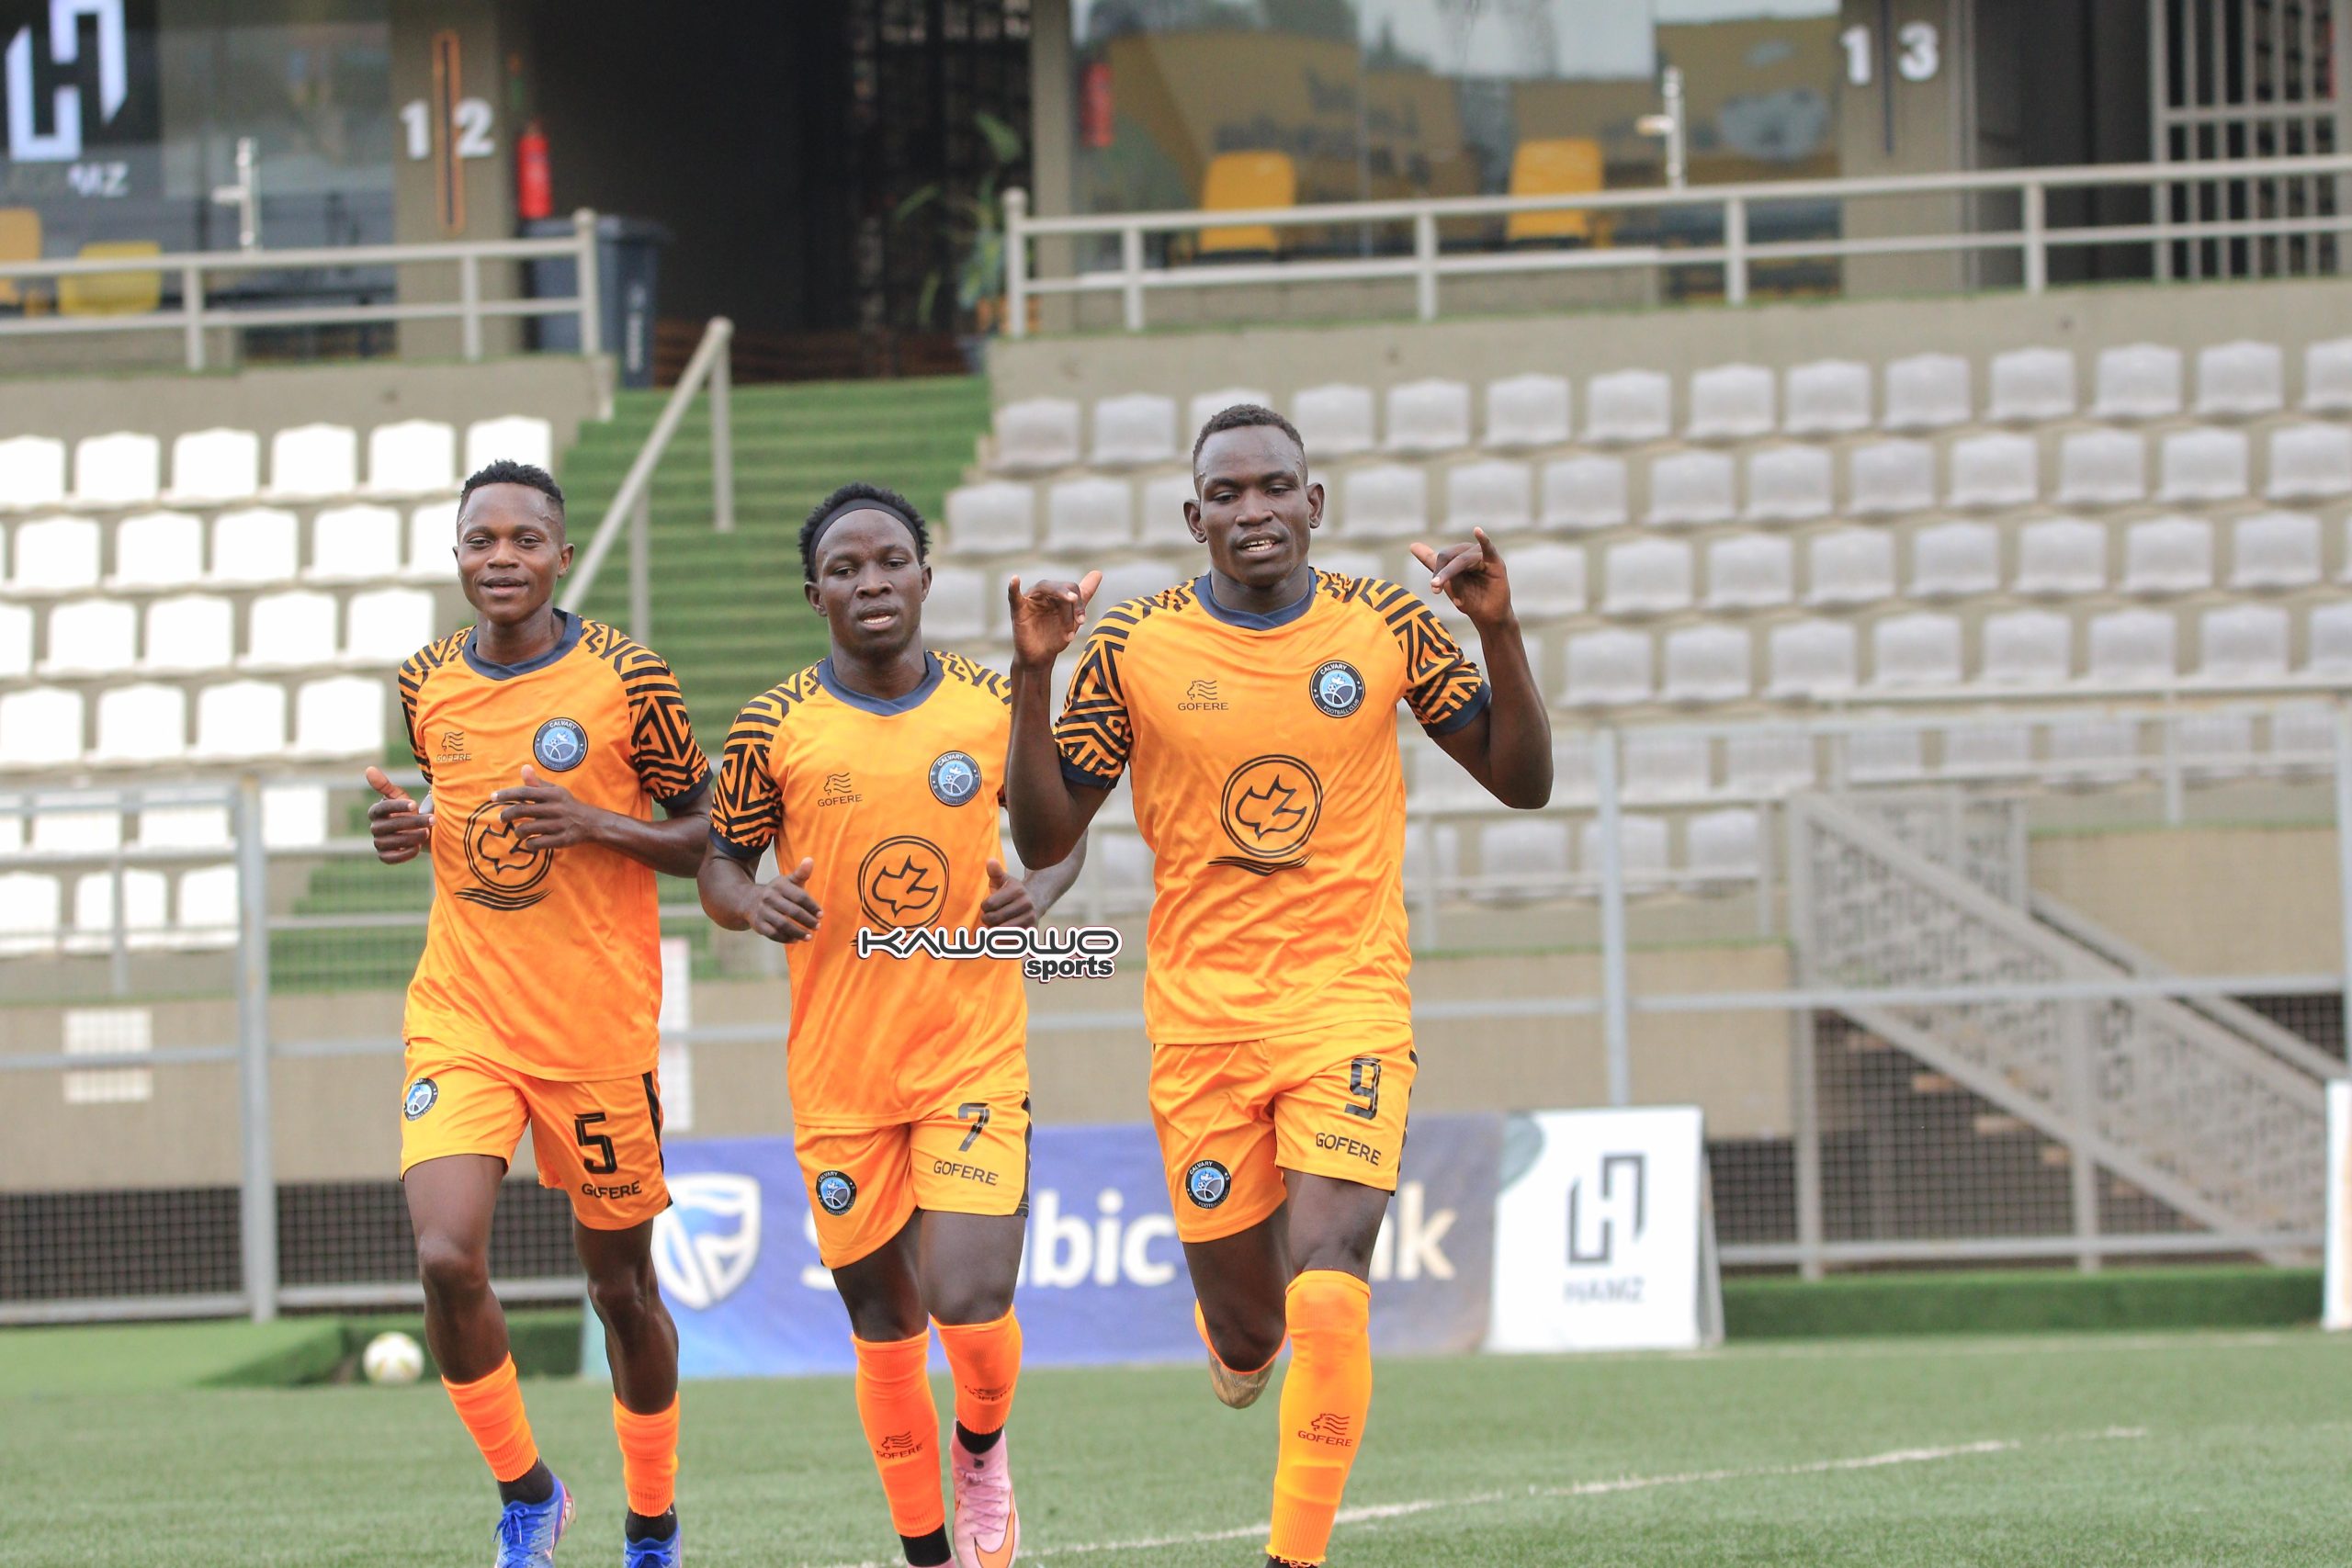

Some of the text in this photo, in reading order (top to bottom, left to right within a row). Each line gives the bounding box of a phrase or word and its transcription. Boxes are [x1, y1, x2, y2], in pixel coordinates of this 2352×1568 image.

[1319, 662, 1348, 675] CALVARY
[1178, 702, 1229, 712] GOFERE
[1323, 705, 1350, 715] FOOTBALL
[549, 720, 577, 730] CALVARY
[436, 753, 472, 761] GOFERE
[937, 753, 964, 767] CALVARY
[818, 794, 863, 807] GOFERE
[1344, 1057, 1381, 1121] 9
[957, 1102, 989, 1152] 7
[574, 1111, 617, 1175] 5
[1315, 1132, 1382, 1167] GOFERE
[933, 1160, 999, 1186] GOFERE
[1189, 1161, 1213, 1175] CALVARY
[818, 1171, 838, 1183] CALVARY
[1297, 1430, 1353, 1447] GOFERE
